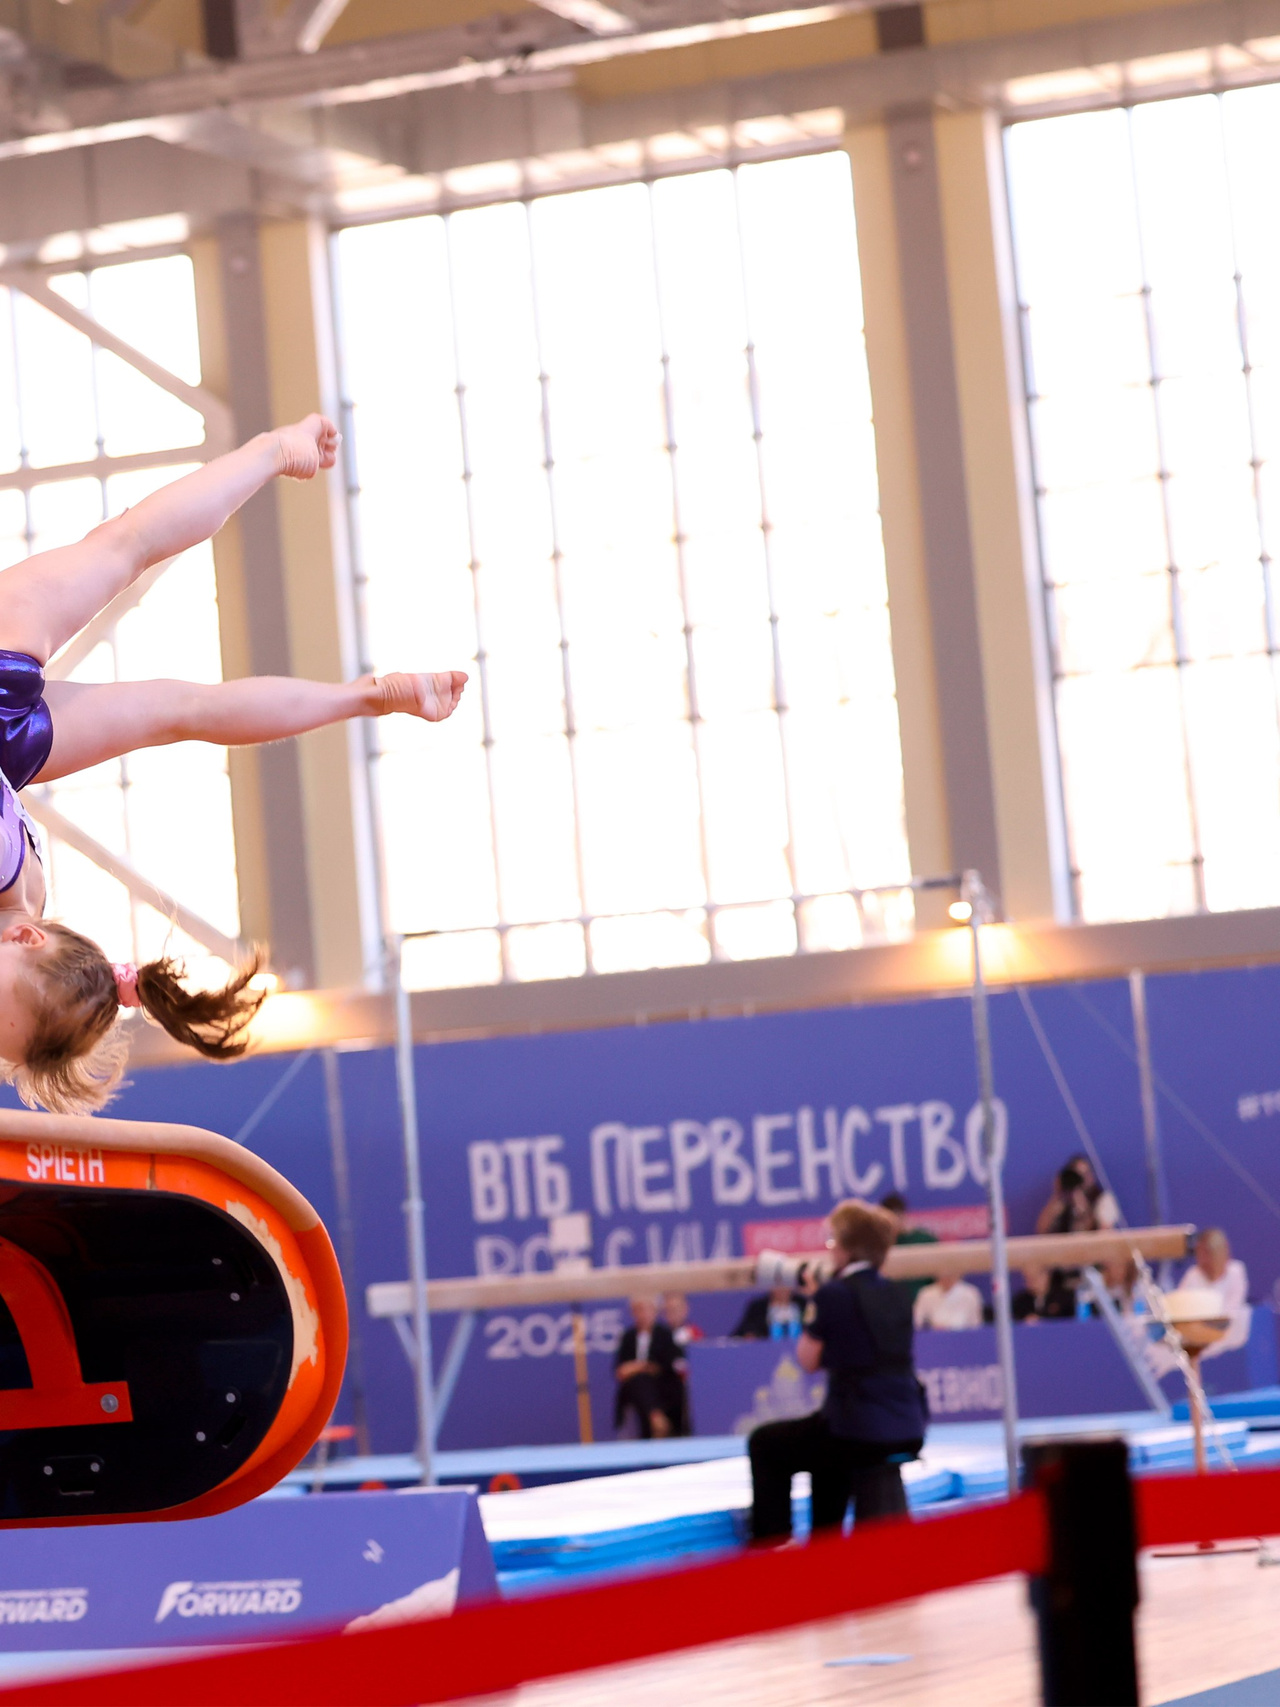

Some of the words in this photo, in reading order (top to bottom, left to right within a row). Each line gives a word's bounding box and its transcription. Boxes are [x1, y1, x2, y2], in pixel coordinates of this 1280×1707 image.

[26, 1143, 104, 1183] SPIETH
[469, 1135, 571, 1223] ВТБ
[590, 1099, 1008, 1217] ПЕРВЕНСТВО
[155, 1581, 303, 1623] FORWARD
